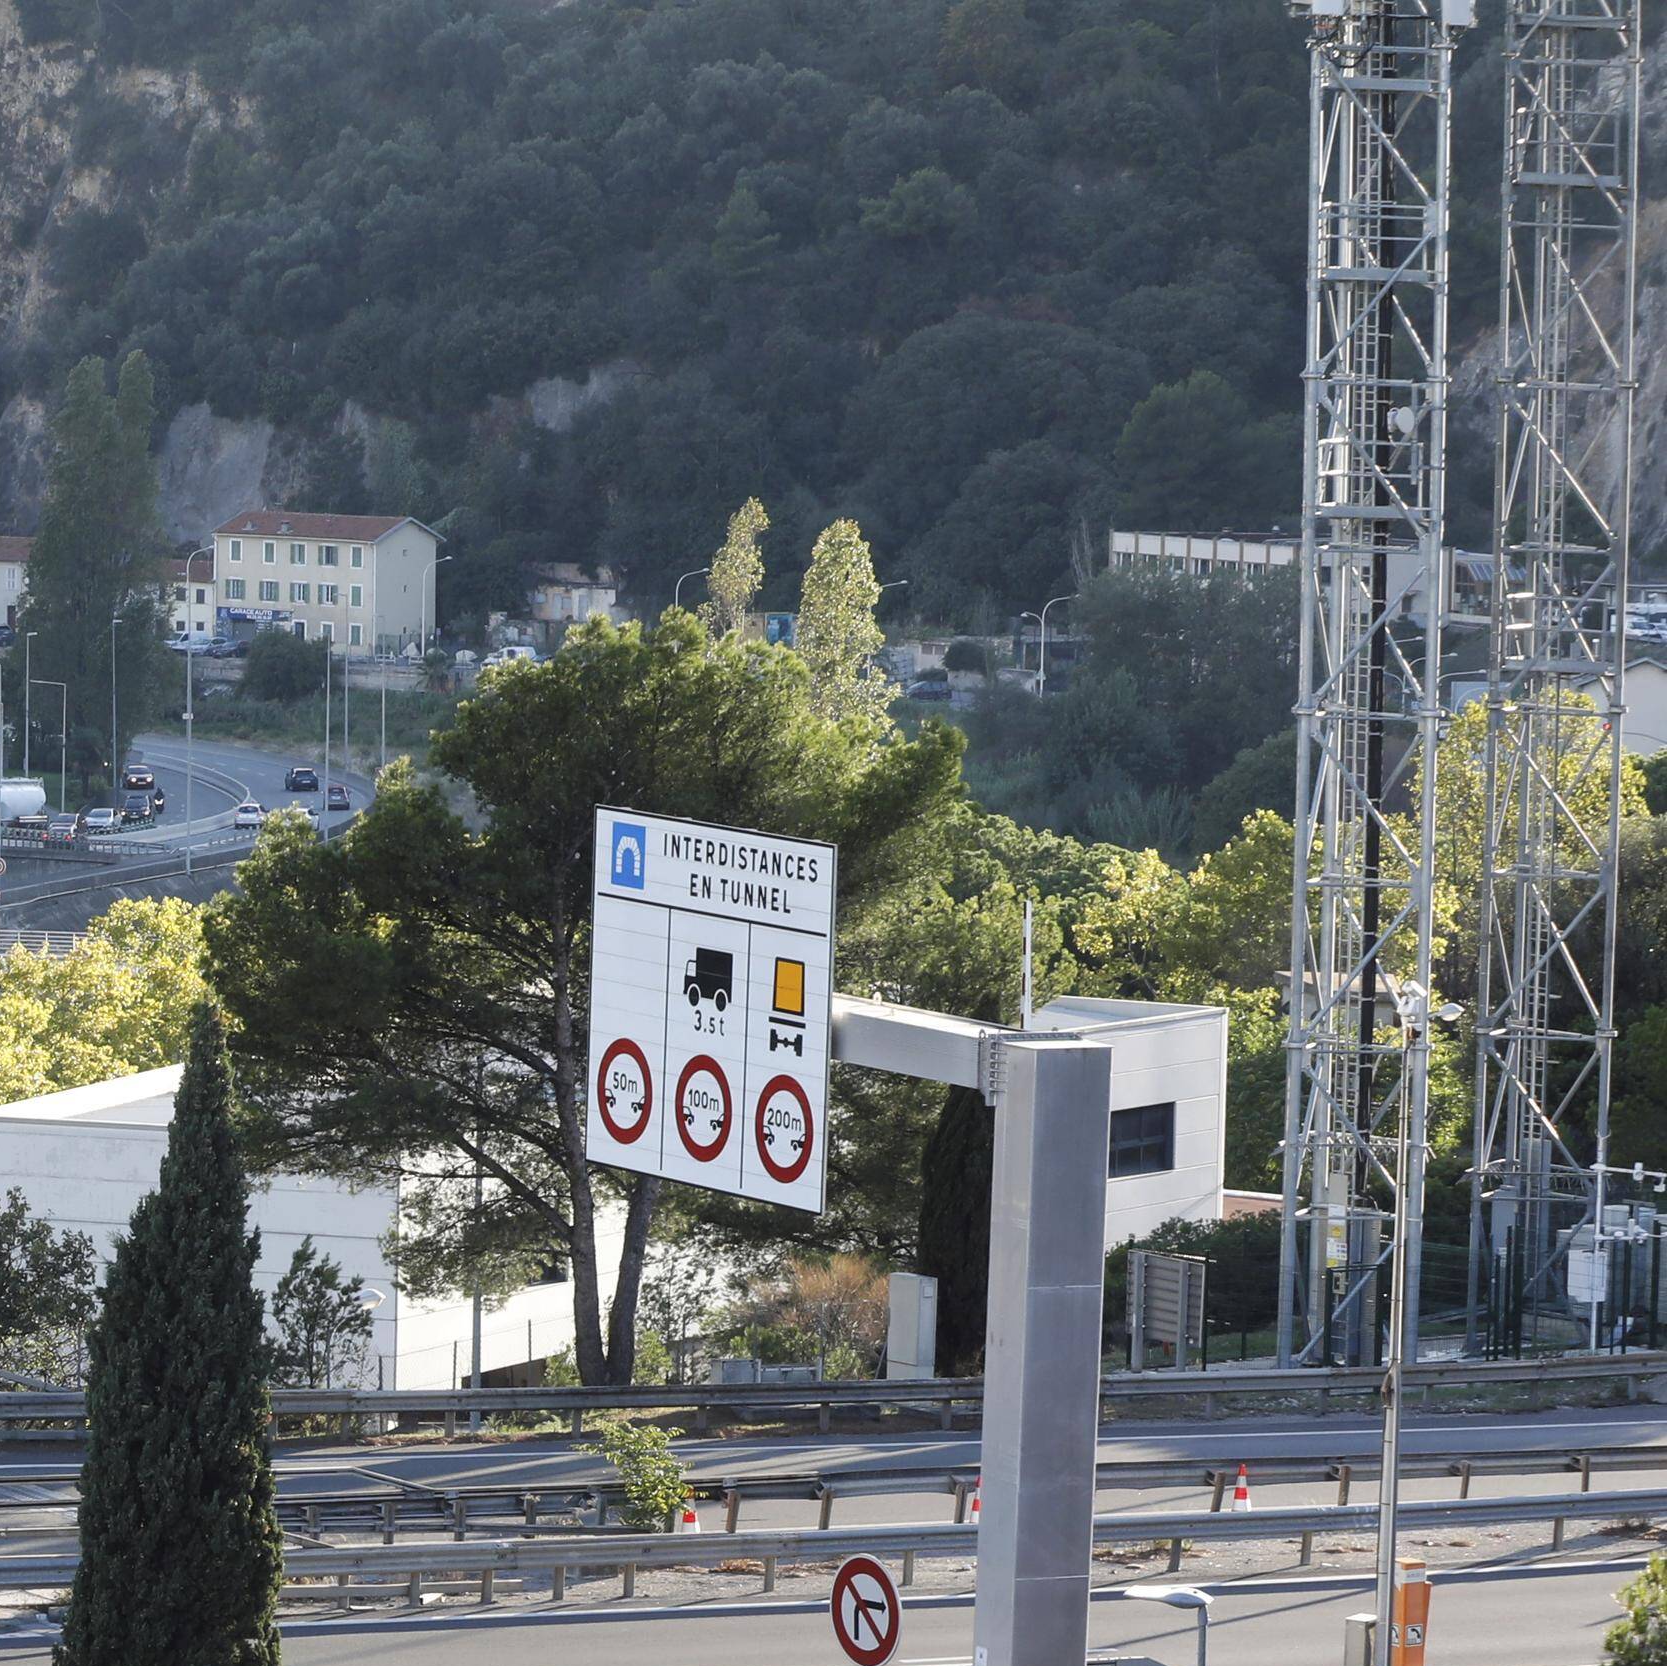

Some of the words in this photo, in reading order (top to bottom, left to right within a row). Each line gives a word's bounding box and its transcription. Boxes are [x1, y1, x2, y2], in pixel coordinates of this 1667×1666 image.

[663, 832, 819, 883] INTERDISTANCES
[689, 873, 712, 899] EN
[720, 878, 791, 914] TUNNEL
[612, 1071, 638, 1094] 50m
[687, 1088, 720, 1112] 100m
[766, 1107, 803, 1132] 200m
